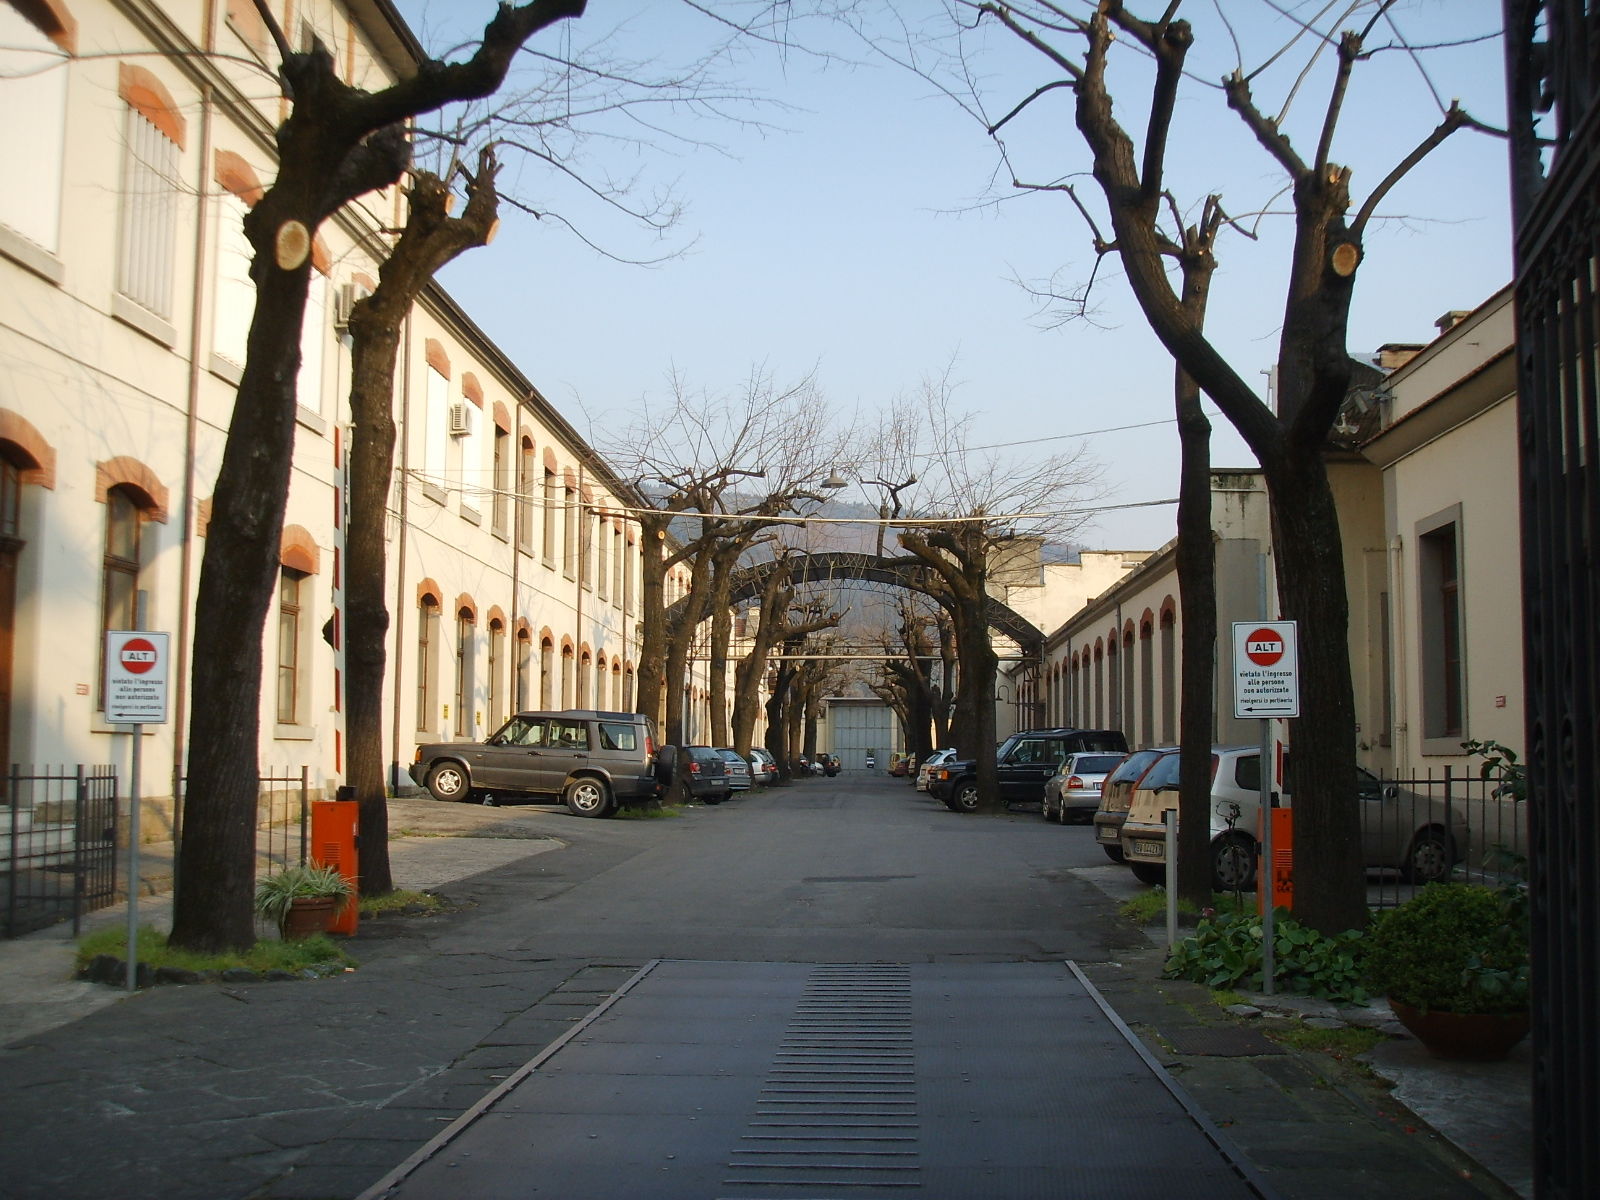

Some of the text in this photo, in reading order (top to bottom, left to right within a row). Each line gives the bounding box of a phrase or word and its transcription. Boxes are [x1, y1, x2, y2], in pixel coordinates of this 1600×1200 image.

[1255, 643, 1276, 651] ALT
[129, 652, 149, 661] ALT
[1262, 670, 1292, 678] l'ingresso
